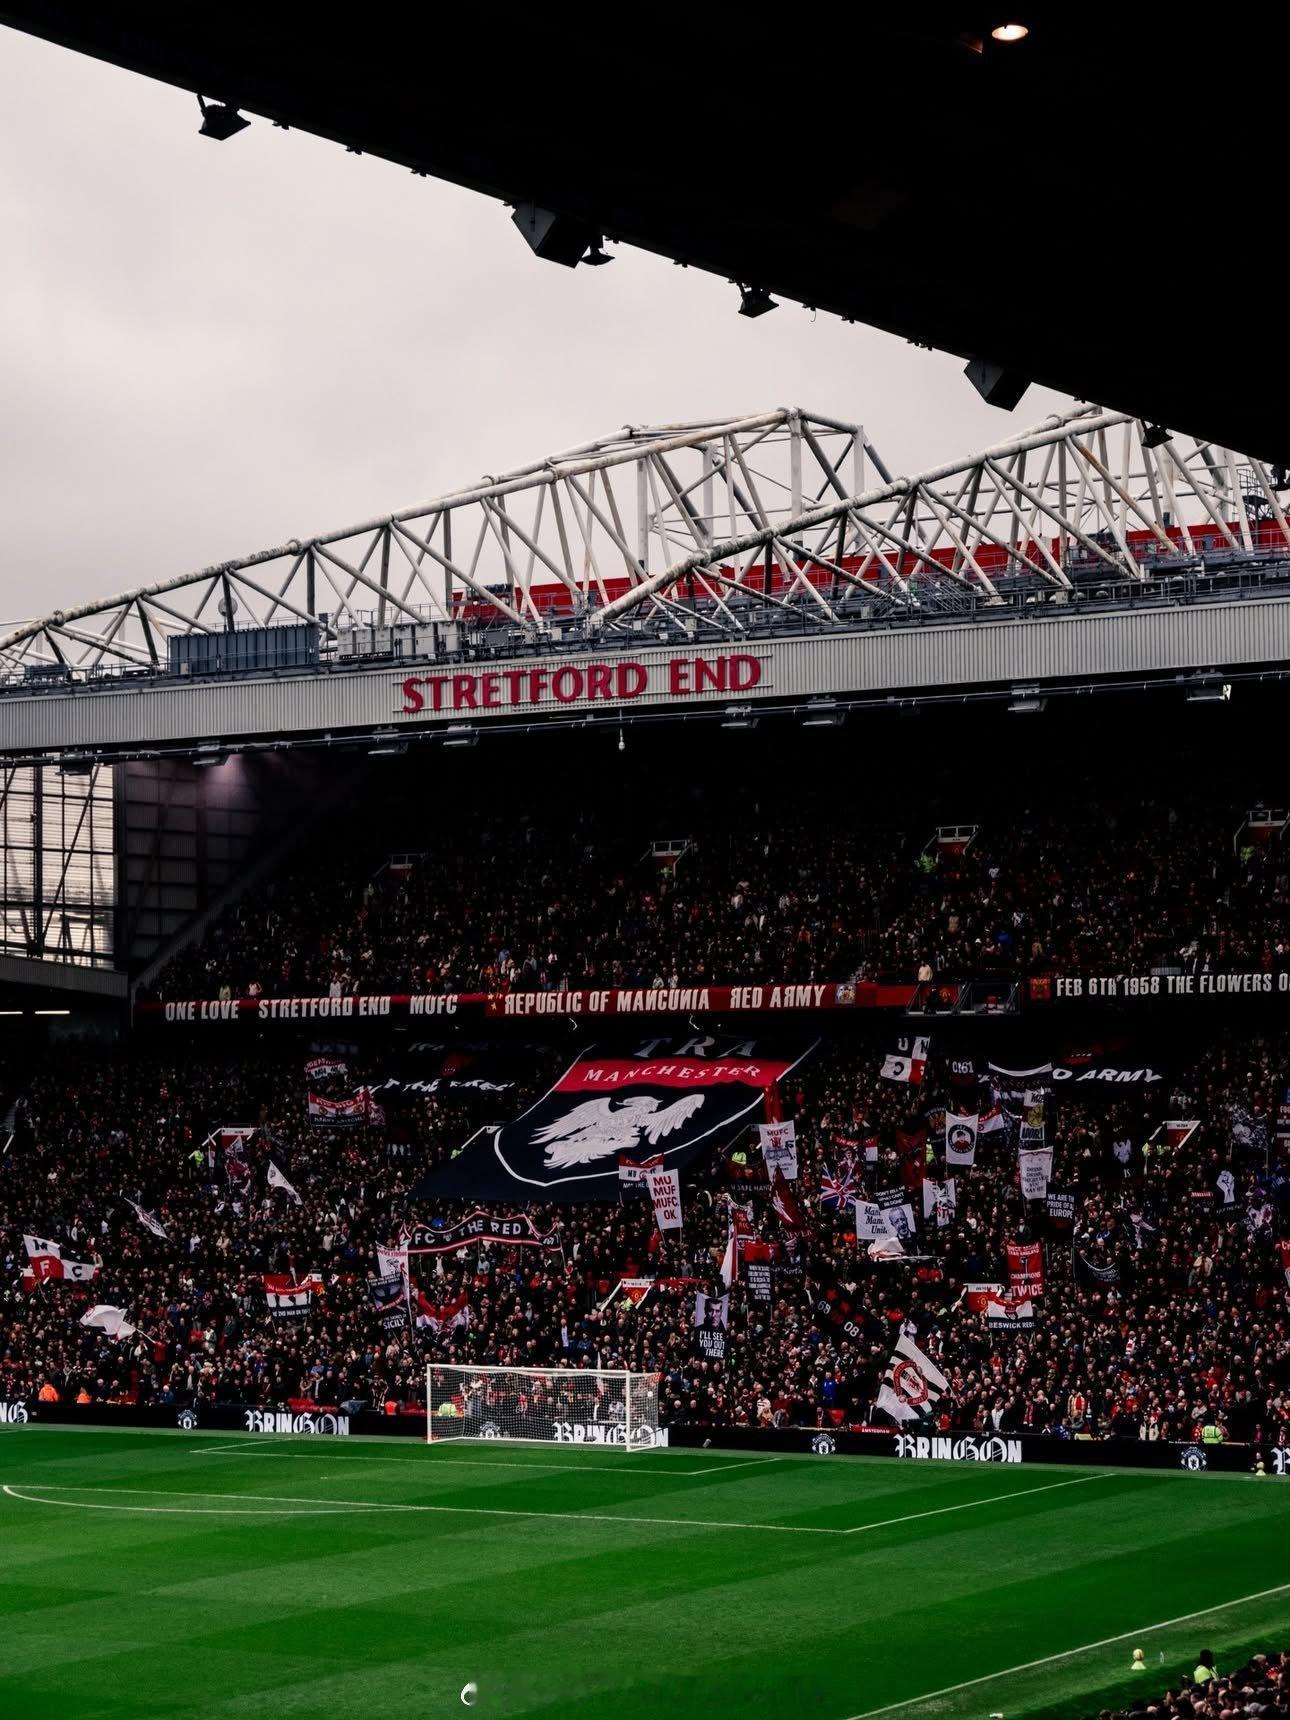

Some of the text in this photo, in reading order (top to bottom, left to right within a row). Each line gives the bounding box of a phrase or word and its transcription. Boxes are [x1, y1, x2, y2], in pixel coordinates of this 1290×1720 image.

[402, 654, 762, 714] STRETFORD END
[1056, 972, 1290, 997] FEB 6TH 1958 THE FLOWERS O
[165, 994, 458, 1021] ONE LOVE STRETFORD END MUFC
[589, 991, 611, 1012] OF
[952, 1060, 974, 1074] 0161
[583, 1065, 761, 1082] MANCHESTER
[1075, 1067, 1164, 1083] ARMY
[767, 1128, 789, 1136] MUFC
[653, 1175, 672, 1187] MU
[653, 1185, 676, 1197] MUF
[1047, 1193, 1058, 1201] WE
[1058, 1193, 1067, 1201] ARE
[1046, 1200, 1063, 1209] PRIDE
[663, 1209, 677, 1220] OK
[1049, 1207, 1074, 1219] EUROPE
[414, 1219, 521, 1245] FC THE RED
[1011, 1284, 1043, 1297] TWICE
[383, 1318, 405, 1330] SICILY
[843, 1321, 860, 1337] 08
[988, 1321, 1022, 1329] BESWICK
[699, 1330, 724, 1341] I'LL SEE
[699, 1339, 725, 1349] YOU OUT
[705, 1348, 724, 1358] THERE
